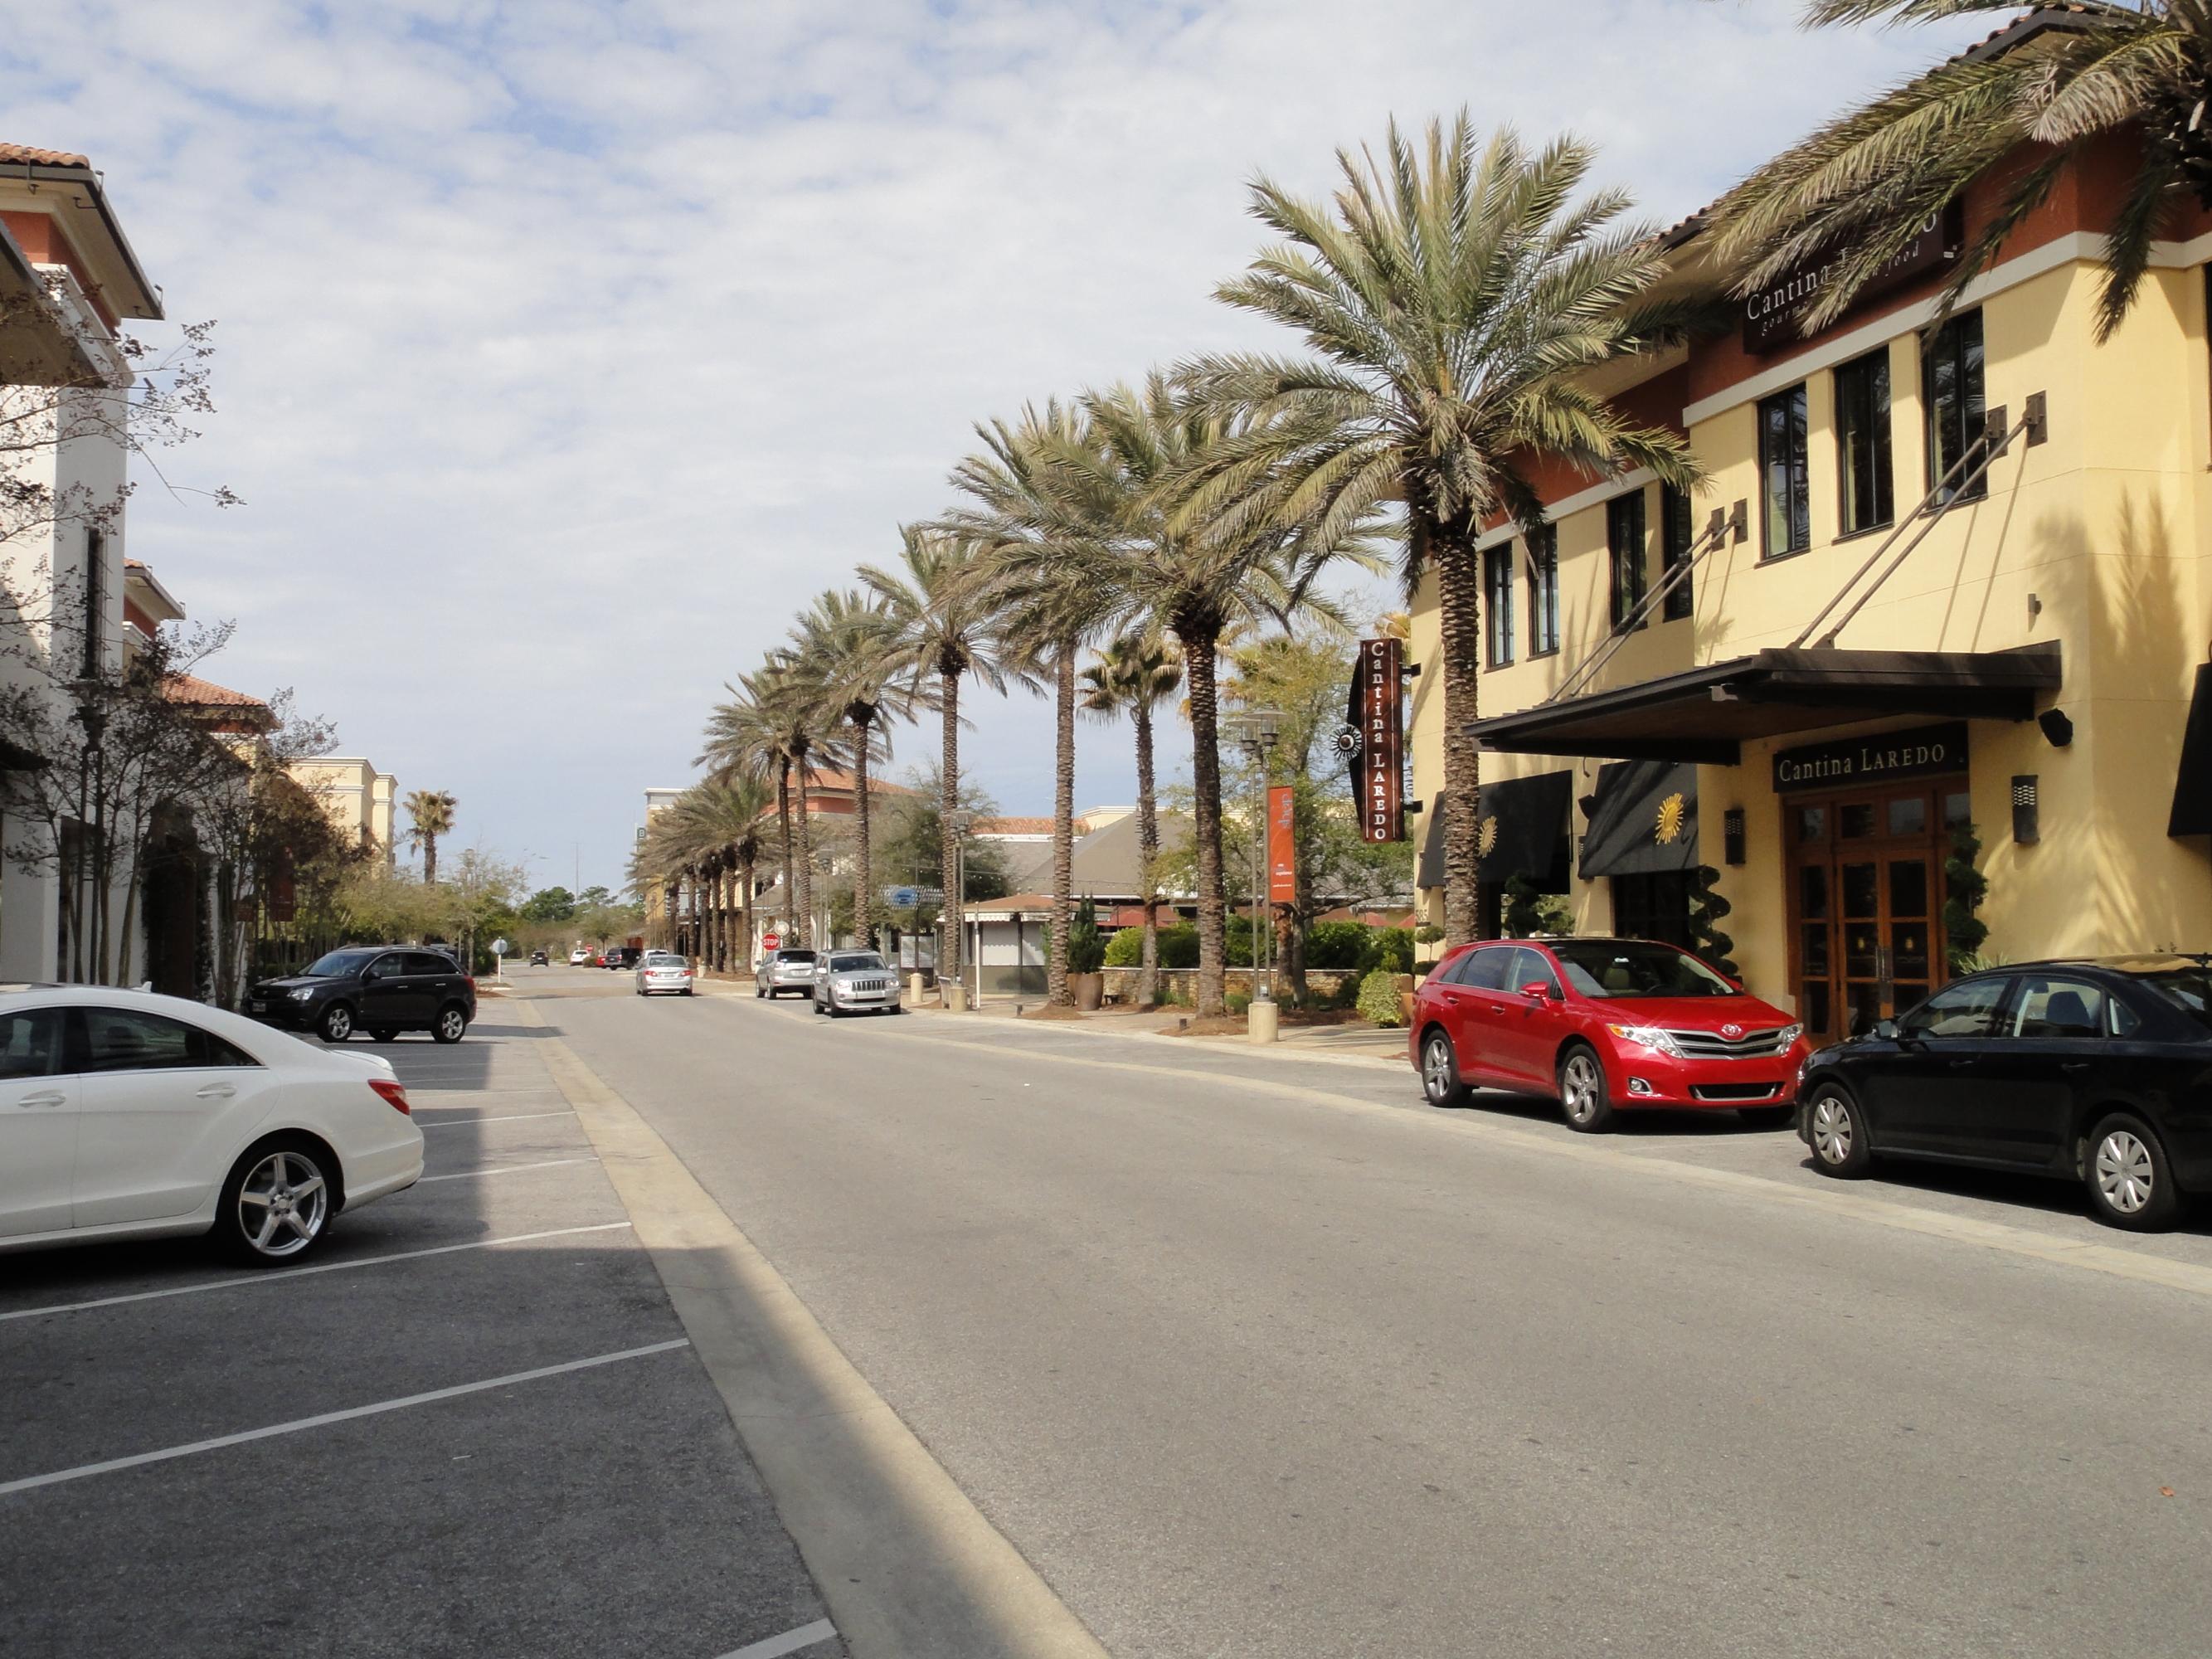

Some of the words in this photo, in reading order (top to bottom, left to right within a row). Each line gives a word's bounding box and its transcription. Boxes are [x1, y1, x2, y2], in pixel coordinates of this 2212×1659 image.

[1747, 265, 1830, 320] Cantina
[1371, 642, 1385, 743] Cantina
[1779, 754, 1852, 781] Cantina
[1860, 743, 1945, 771] LAREDO
[1373, 753, 1386, 840] LAREDO
[763, 938, 779, 946] STOP
